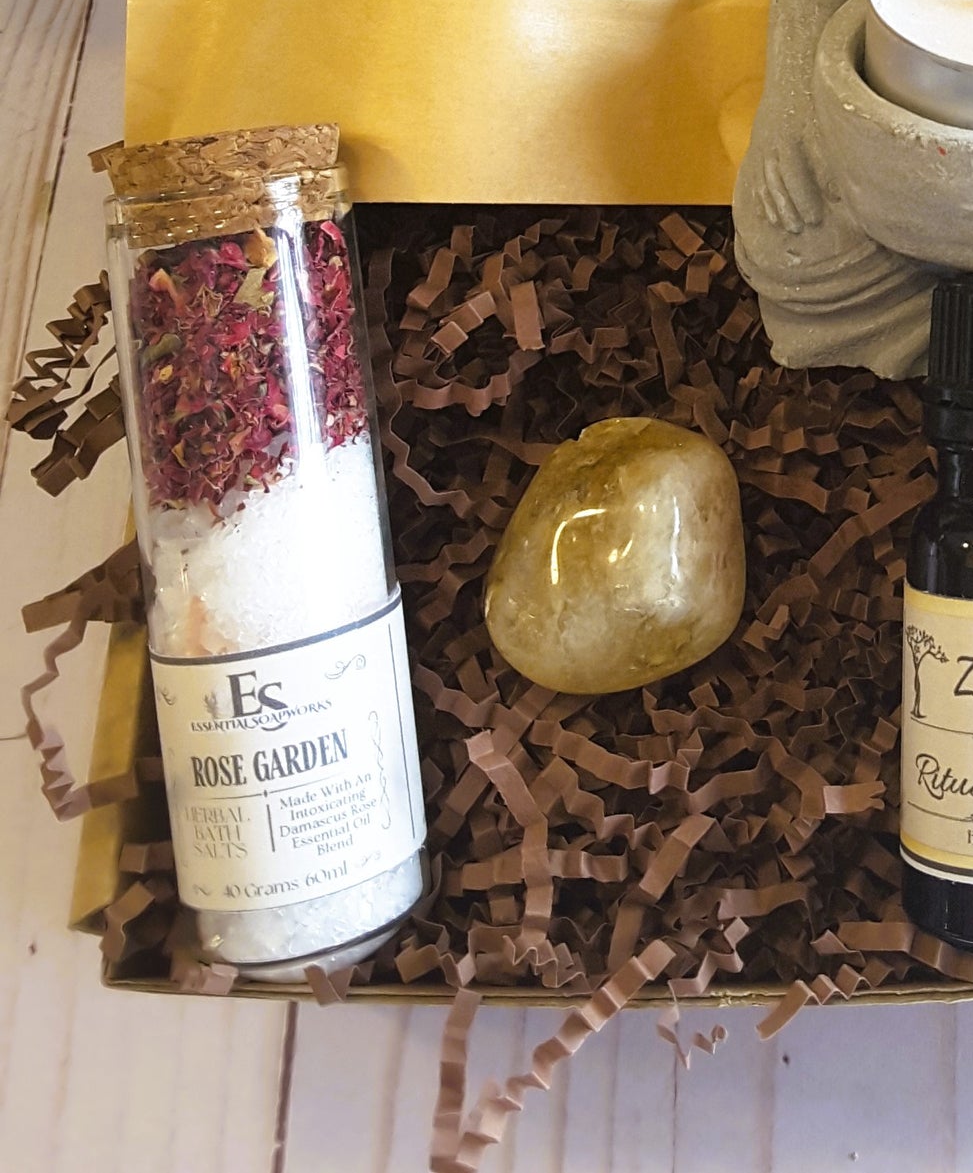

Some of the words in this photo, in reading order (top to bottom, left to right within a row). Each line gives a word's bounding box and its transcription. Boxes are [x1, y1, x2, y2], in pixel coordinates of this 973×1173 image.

[191, 754, 247, 788] ROSE
[253, 728, 348, 782] GARDEN
[280, 791, 317, 810] Made
[320, 779, 352, 797] With
[355, 773, 372, 787] An
[290, 787, 367, 821] Intoxicating
[279, 810, 347, 838] Damascus
[292, 821, 350, 849] Essential
[317, 833, 353, 856] Blend
[244, 879, 300, 898] Grams
